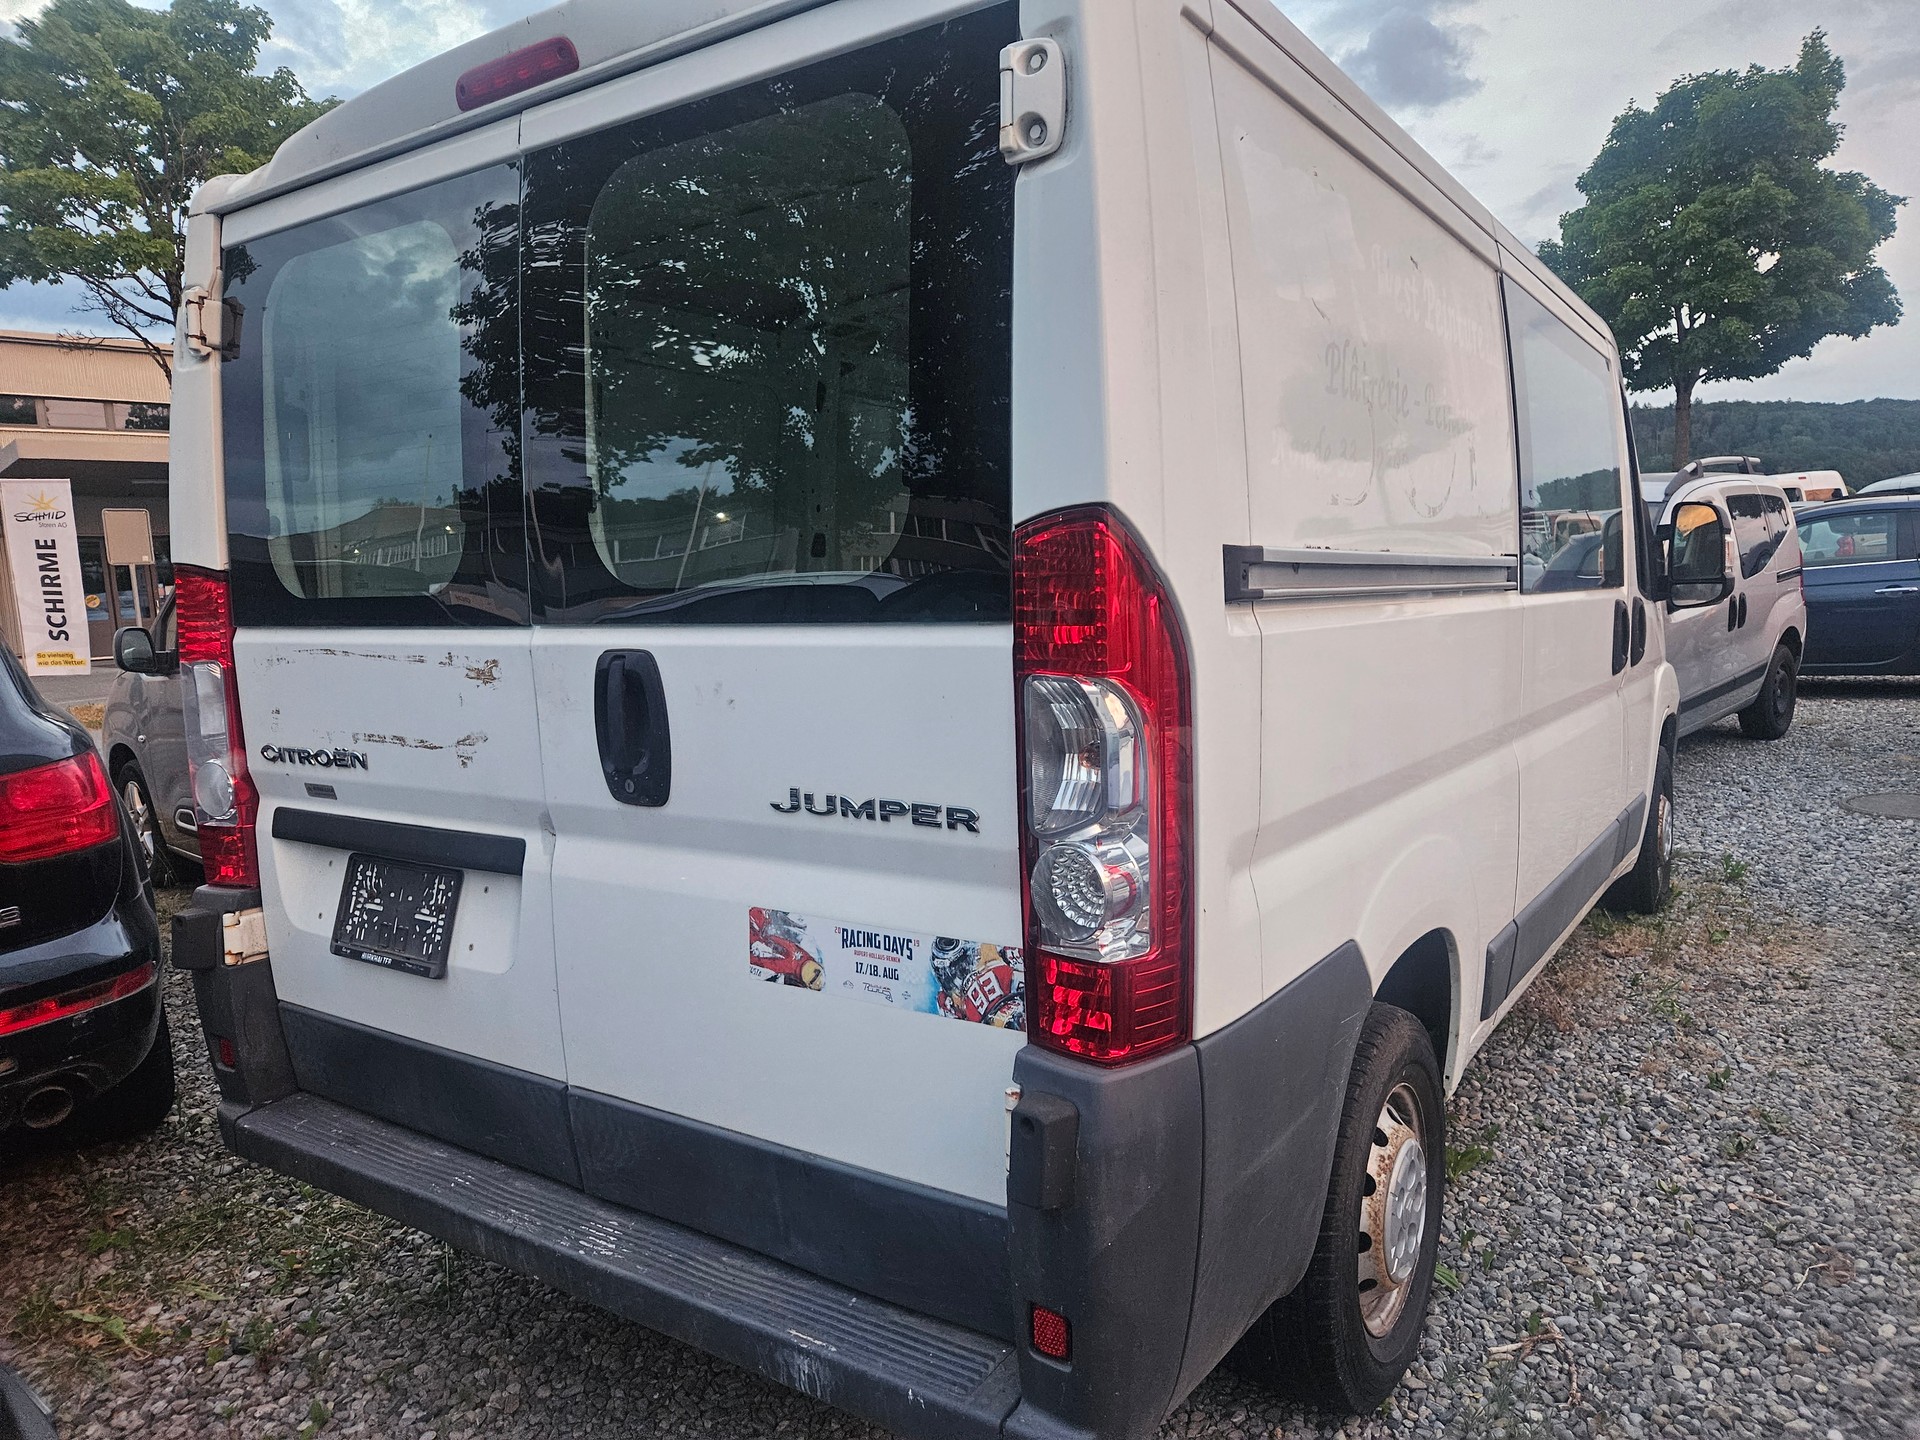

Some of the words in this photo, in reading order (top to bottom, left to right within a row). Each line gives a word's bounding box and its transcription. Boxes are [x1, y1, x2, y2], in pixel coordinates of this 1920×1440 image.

[13, 510, 66, 522] SCHMID
[34, 538, 70, 642] SCHIRME
[260, 742, 369, 771] CITROËN
[769, 785, 981, 834] JUMPER
[841, 927, 881, 949] RACING
[883, 934, 913, 961] DAYS
[882, 966, 900, 981] AUG
[966, 969, 1005, 1016] 93
